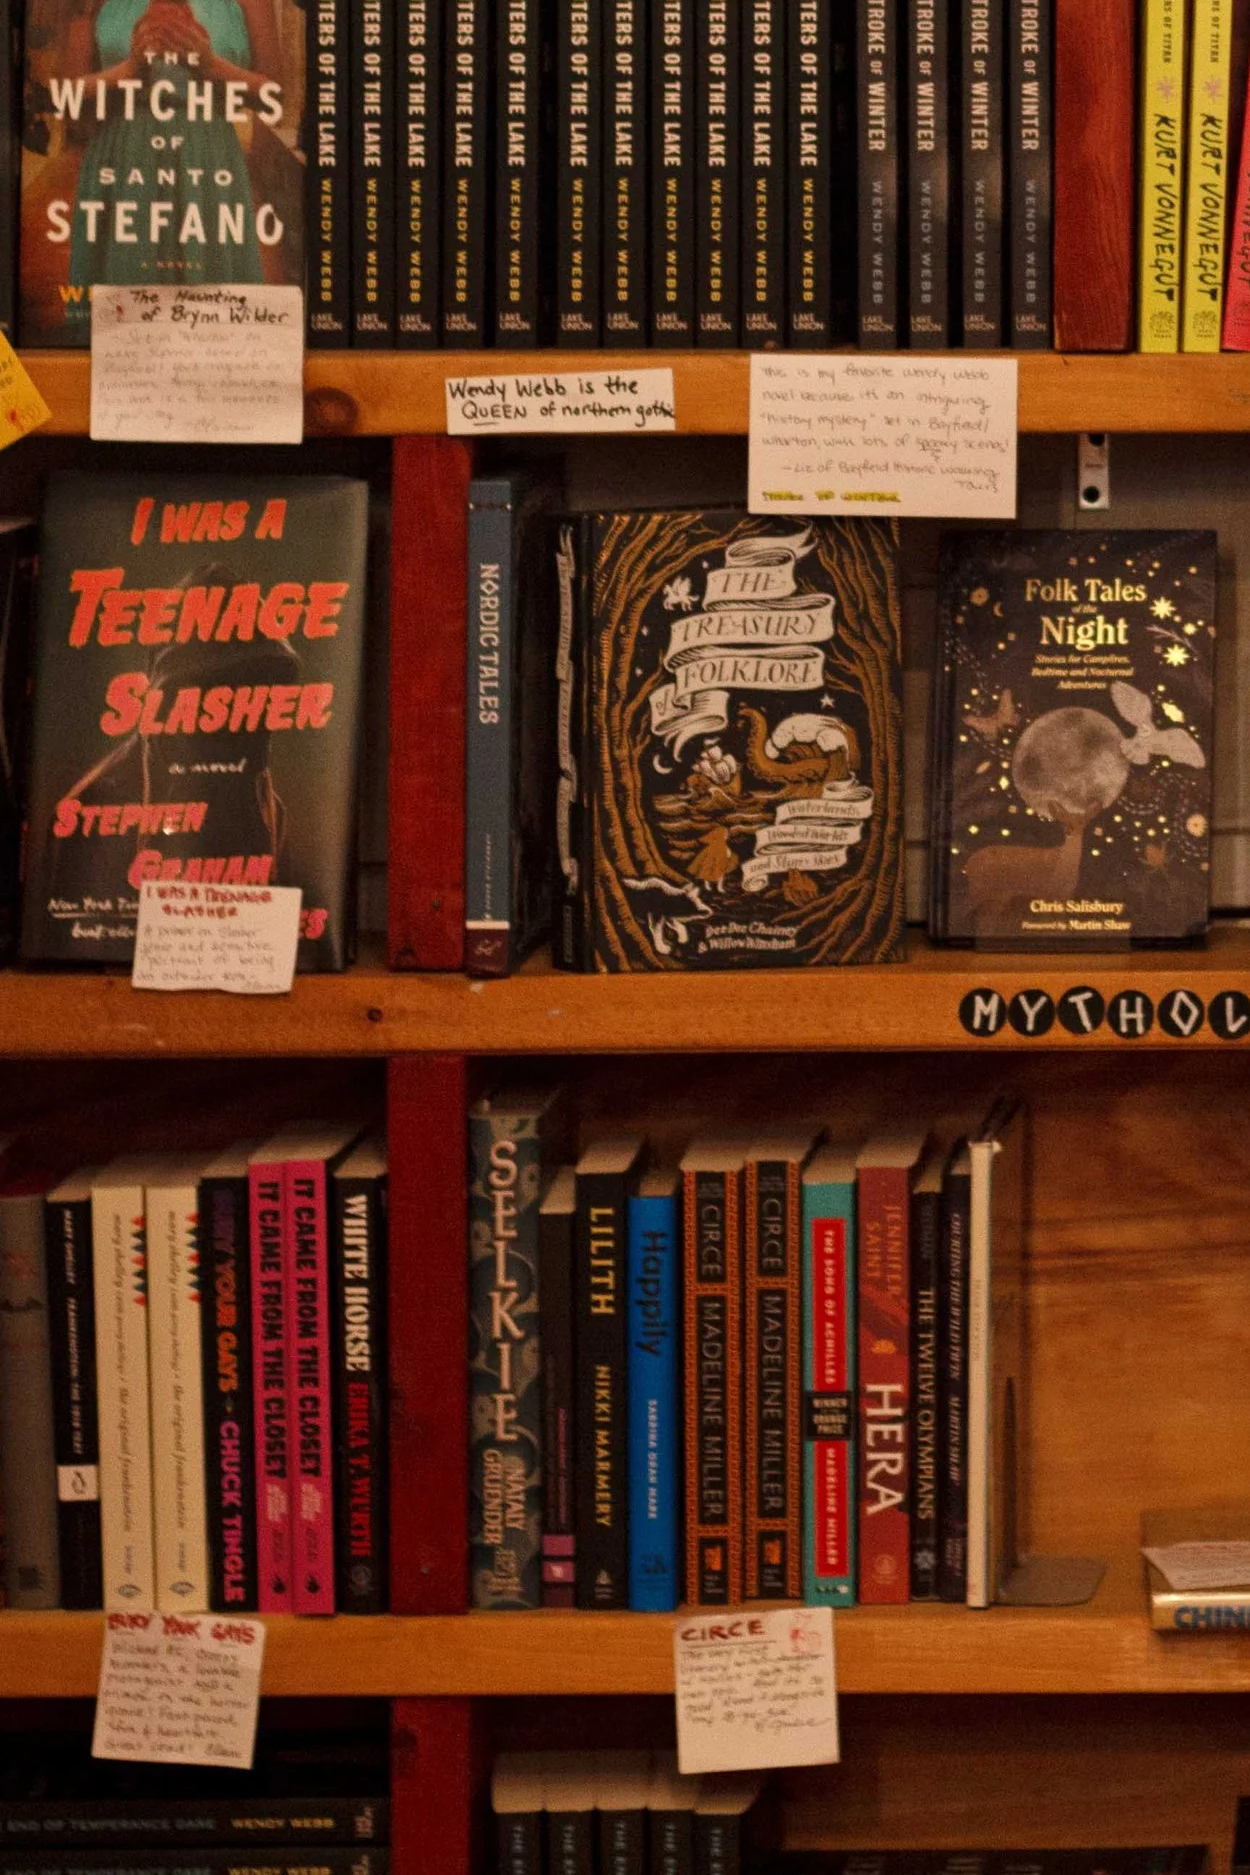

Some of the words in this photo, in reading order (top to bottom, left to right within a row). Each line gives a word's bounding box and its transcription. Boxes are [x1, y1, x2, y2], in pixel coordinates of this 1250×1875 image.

[1163, 14, 1172, 27] OF
[143, 51, 200, 66] THE
[318, 53, 335, 76] OF
[870, 61, 882, 75] OF
[1162, 31, 1172, 64] TITAN
[48, 79, 284, 125] WITCHES
[318, 81, 335, 115] THE
[868, 82, 885, 151] WINTER
[150, 135, 184, 151] OF
[318, 122, 335, 167] LAKE
[1153, 113, 1178, 177] KURT
[99, 167, 234, 188] SANTO
[45, 201, 284, 246] STEFANO
[321, 178, 332, 243] WENDY
[1149, 183, 1181, 303] VONNEGUT
[130, 290, 166, 305] The
[175, 289, 249, 308] Haunting
[321, 251, 333, 303] WEBB
[140, 308, 162, 323] of
[169, 307, 216, 328] Brynn
[222, 307, 289, 325] Wilder
[446, 379, 506, 403] Wendy
[515, 376, 567, 397] Webb
[579, 376, 595, 396] is
[603, 374, 639, 396] the
[461, 401, 528, 425] QUEEN
[539, 400, 557, 419] of
[561, 402, 634, 421] northern
[130, 497, 155, 546] I
[160, 501, 250, 544] WAS
[256, 499, 287, 541] A
[479, 562, 500, 645] NORDIC
[719, 568, 784, 593] THE
[1024, 578, 1078, 602] Folk
[1085, 578, 1147, 603] Tales
[69, 567, 350, 648] TEENAGE
[677, 611, 822, 643] TREASURY
[1039, 615, 1128, 651] Night
[478, 649, 500, 725] TALES
[681, 660, 817, 687] FOLKLORE
[100, 672, 334, 737] SLASHER
[53, 799, 208, 839] STEPHEN
[1029, 899, 1063, 912] Chris
[1066, 899, 1124, 916] Salisbury
[294, 1179, 314, 1198] IT
[294, 1207, 317, 1270] CAME
[343, 1194, 369, 1279] WHITE
[701, 1205, 722, 1276] CIRCE
[590, 1207, 615, 1315] LILITH
[297, 1278, 318, 1338] FROM
[489, 1140, 525, 1442] SELKIE
[635, 1231, 669, 1357] Happily
[344, 1287, 371, 1372] HORSE
[298, 1346, 319, 1388] THE
[700, 1302, 723, 1432] MADELINE
[300, 1395, 321, 1477] CLOSET
[865, 1383, 904, 1516] HERA
[220, 1420, 242, 1508] CHUCK
[702, 1435, 723, 1523] MILLER
[222, 1514, 244, 1602] TINGLE
[681, 1618, 767, 1642] CIRCE
